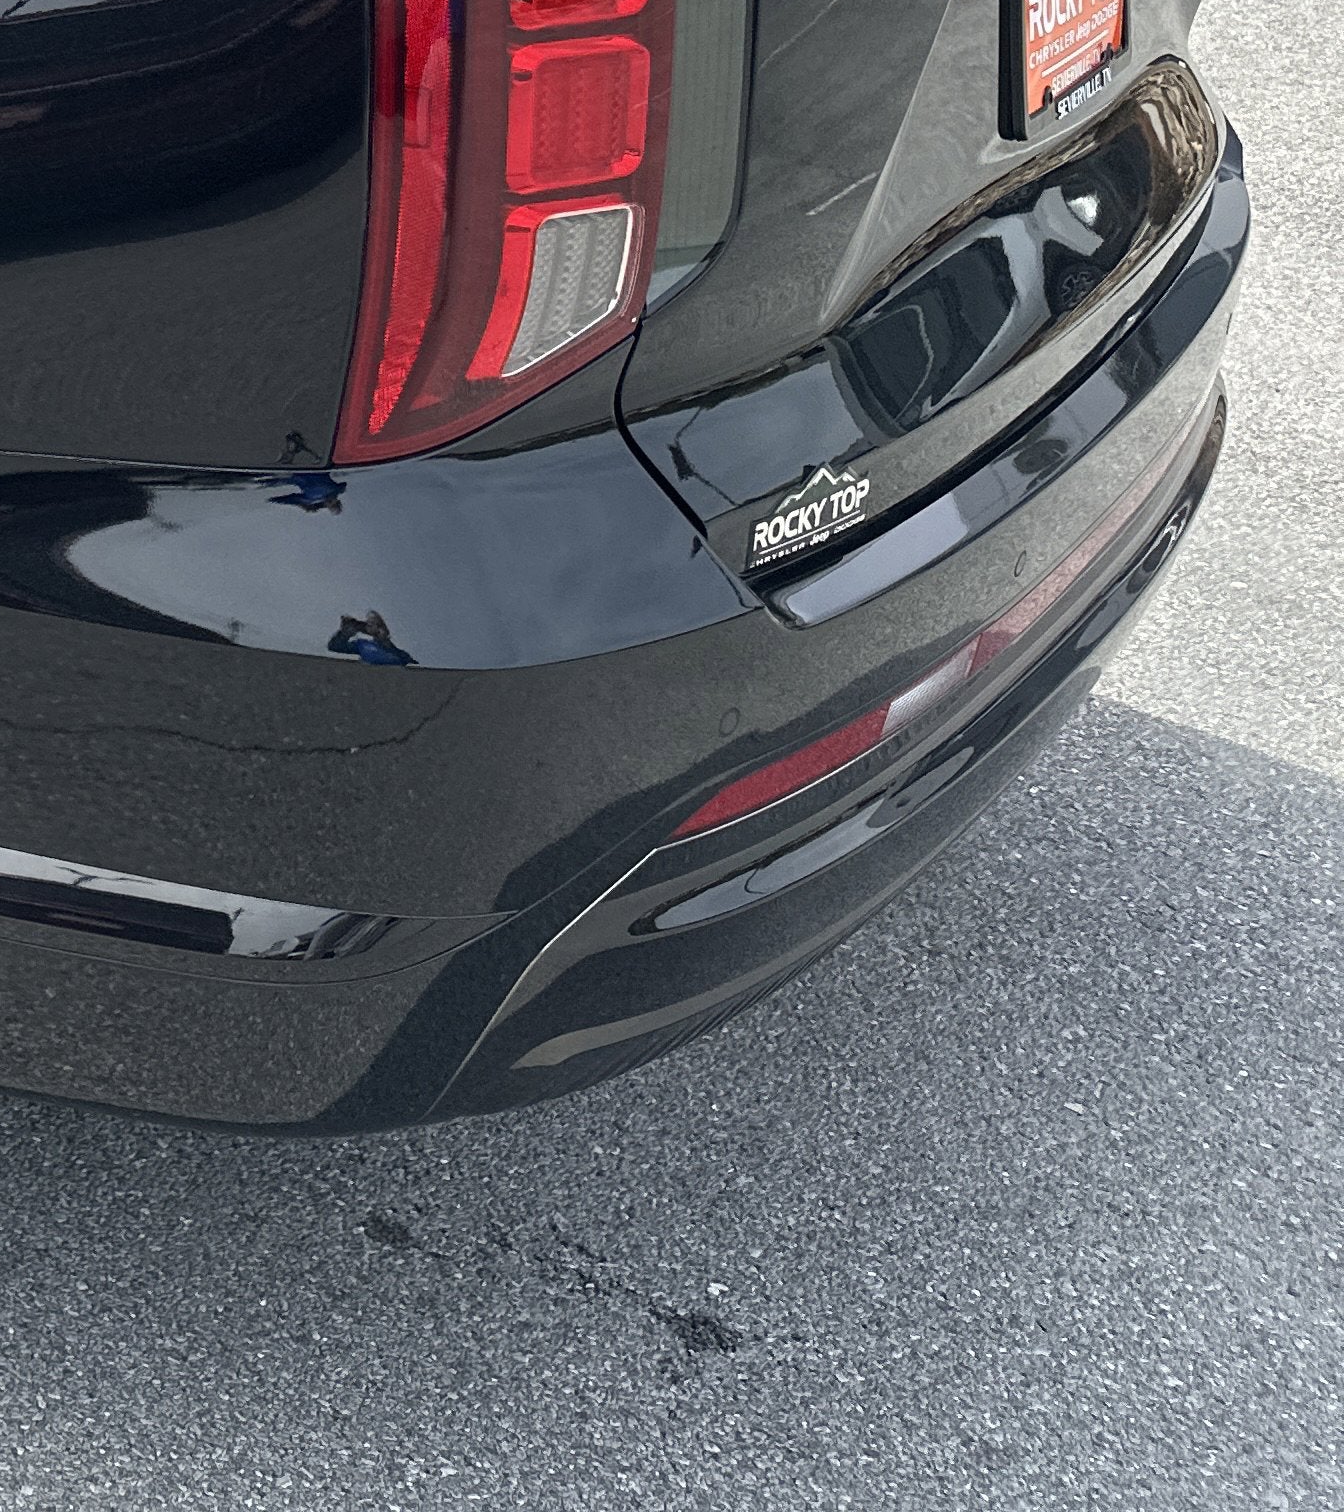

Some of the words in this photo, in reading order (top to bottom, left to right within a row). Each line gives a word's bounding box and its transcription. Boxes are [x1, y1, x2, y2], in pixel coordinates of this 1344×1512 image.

[1029, 29, 1076, 70] CHRYSLER
[753, 497, 828, 552] ROCKY
[829, 478, 870, 520] TOP
[750, 541, 806, 569] CHRYSLER
